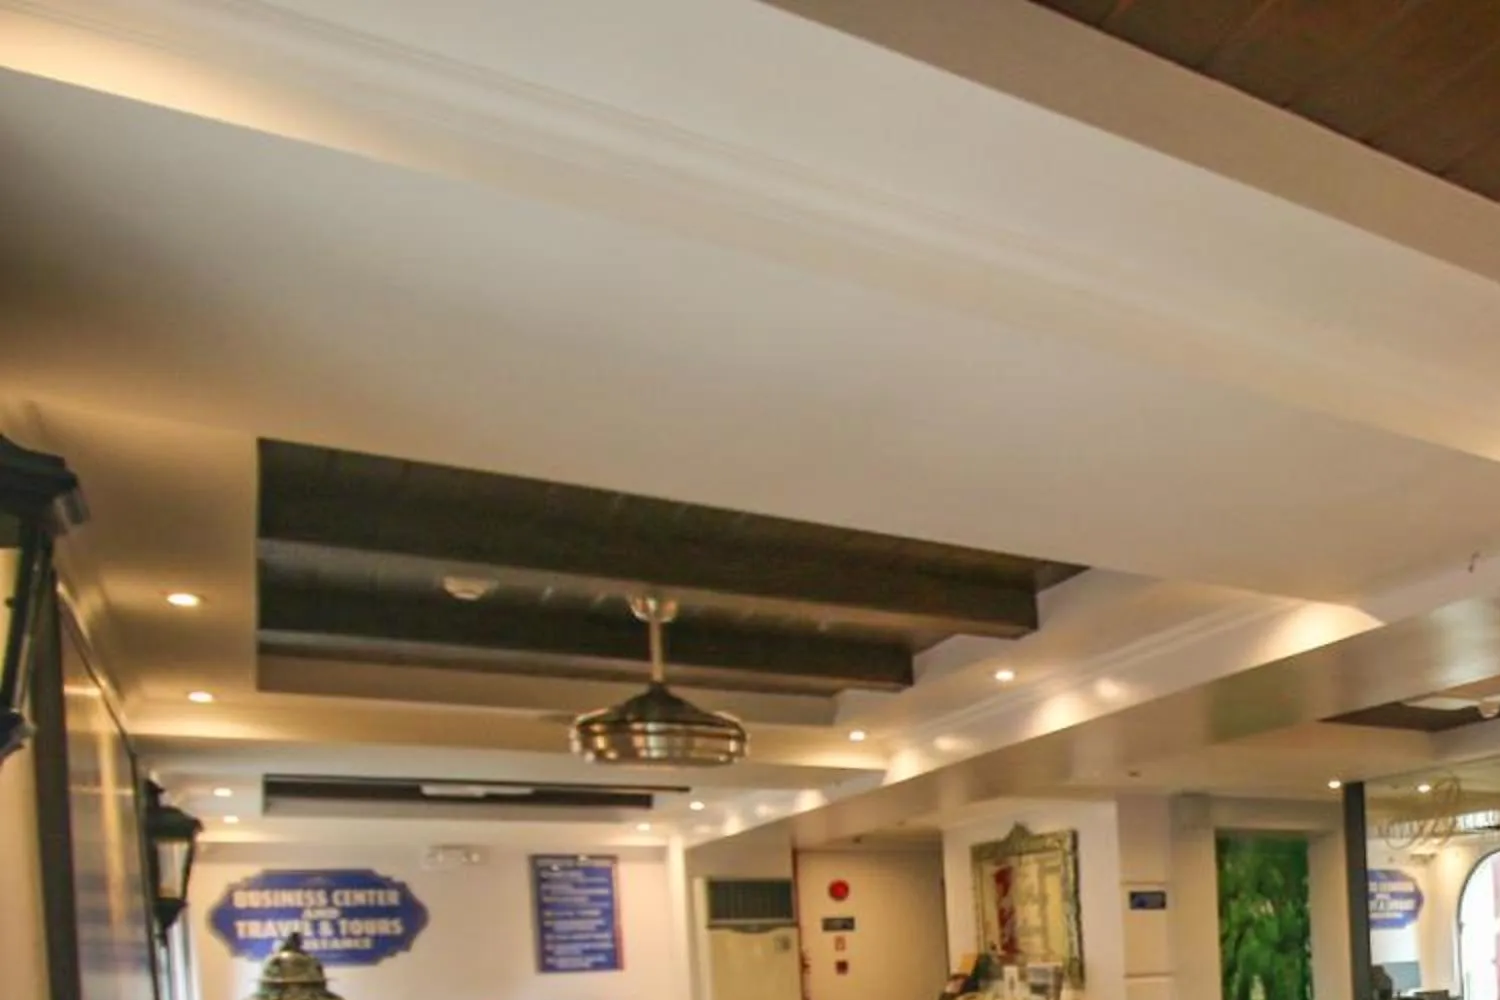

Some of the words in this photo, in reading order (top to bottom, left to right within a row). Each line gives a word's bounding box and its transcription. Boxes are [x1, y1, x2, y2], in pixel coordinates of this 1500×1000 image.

[233, 888, 328, 908] BUSINESS
[332, 888, 401, 907] CENTER
[234, 919, 314, 939] TRAVEL
[337, 917, 404, 936] TOURS
